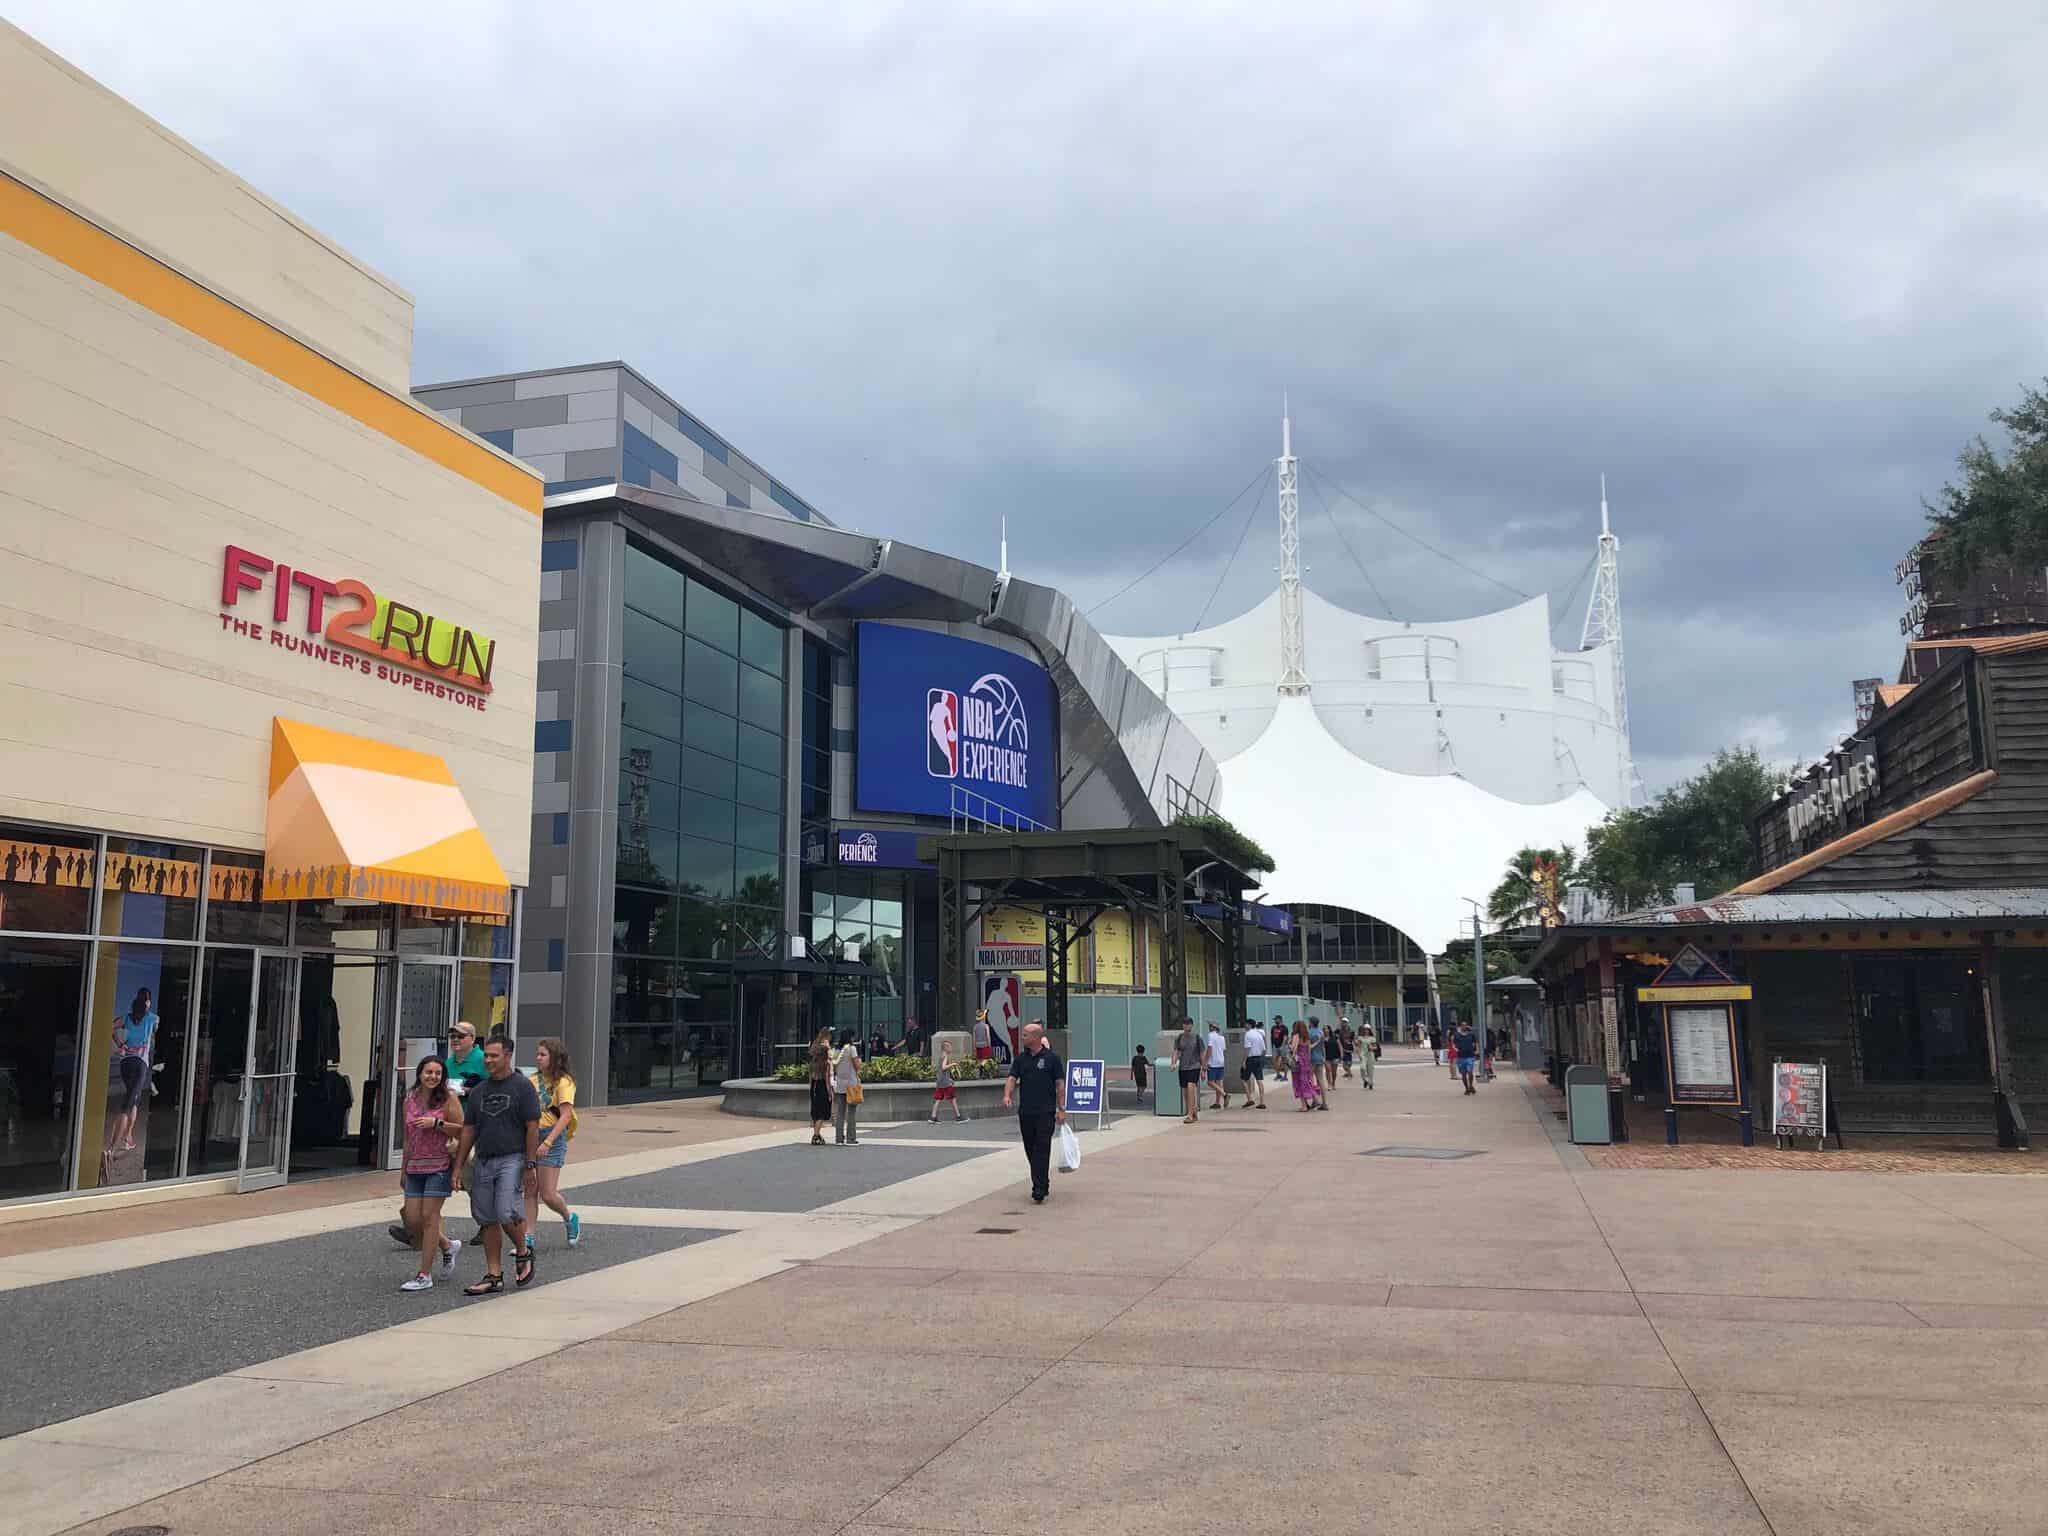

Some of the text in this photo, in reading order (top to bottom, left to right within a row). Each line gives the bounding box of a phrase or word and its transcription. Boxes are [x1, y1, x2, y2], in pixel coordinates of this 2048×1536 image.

[222, 545, 496, 694] FIT2RUN
[219, 613, 487, 712] THE RUNNER'S SUPERSTORE
[963, 695, 994, 742] NBA
[963, 741, 1027, 788] EXPERIENCE
[839, 843, 878, 862] PERIENCE
[978, 948, 1042, 966] NBA EXPERIENCE
[1081, 1067, 1094, 1077] NBA
